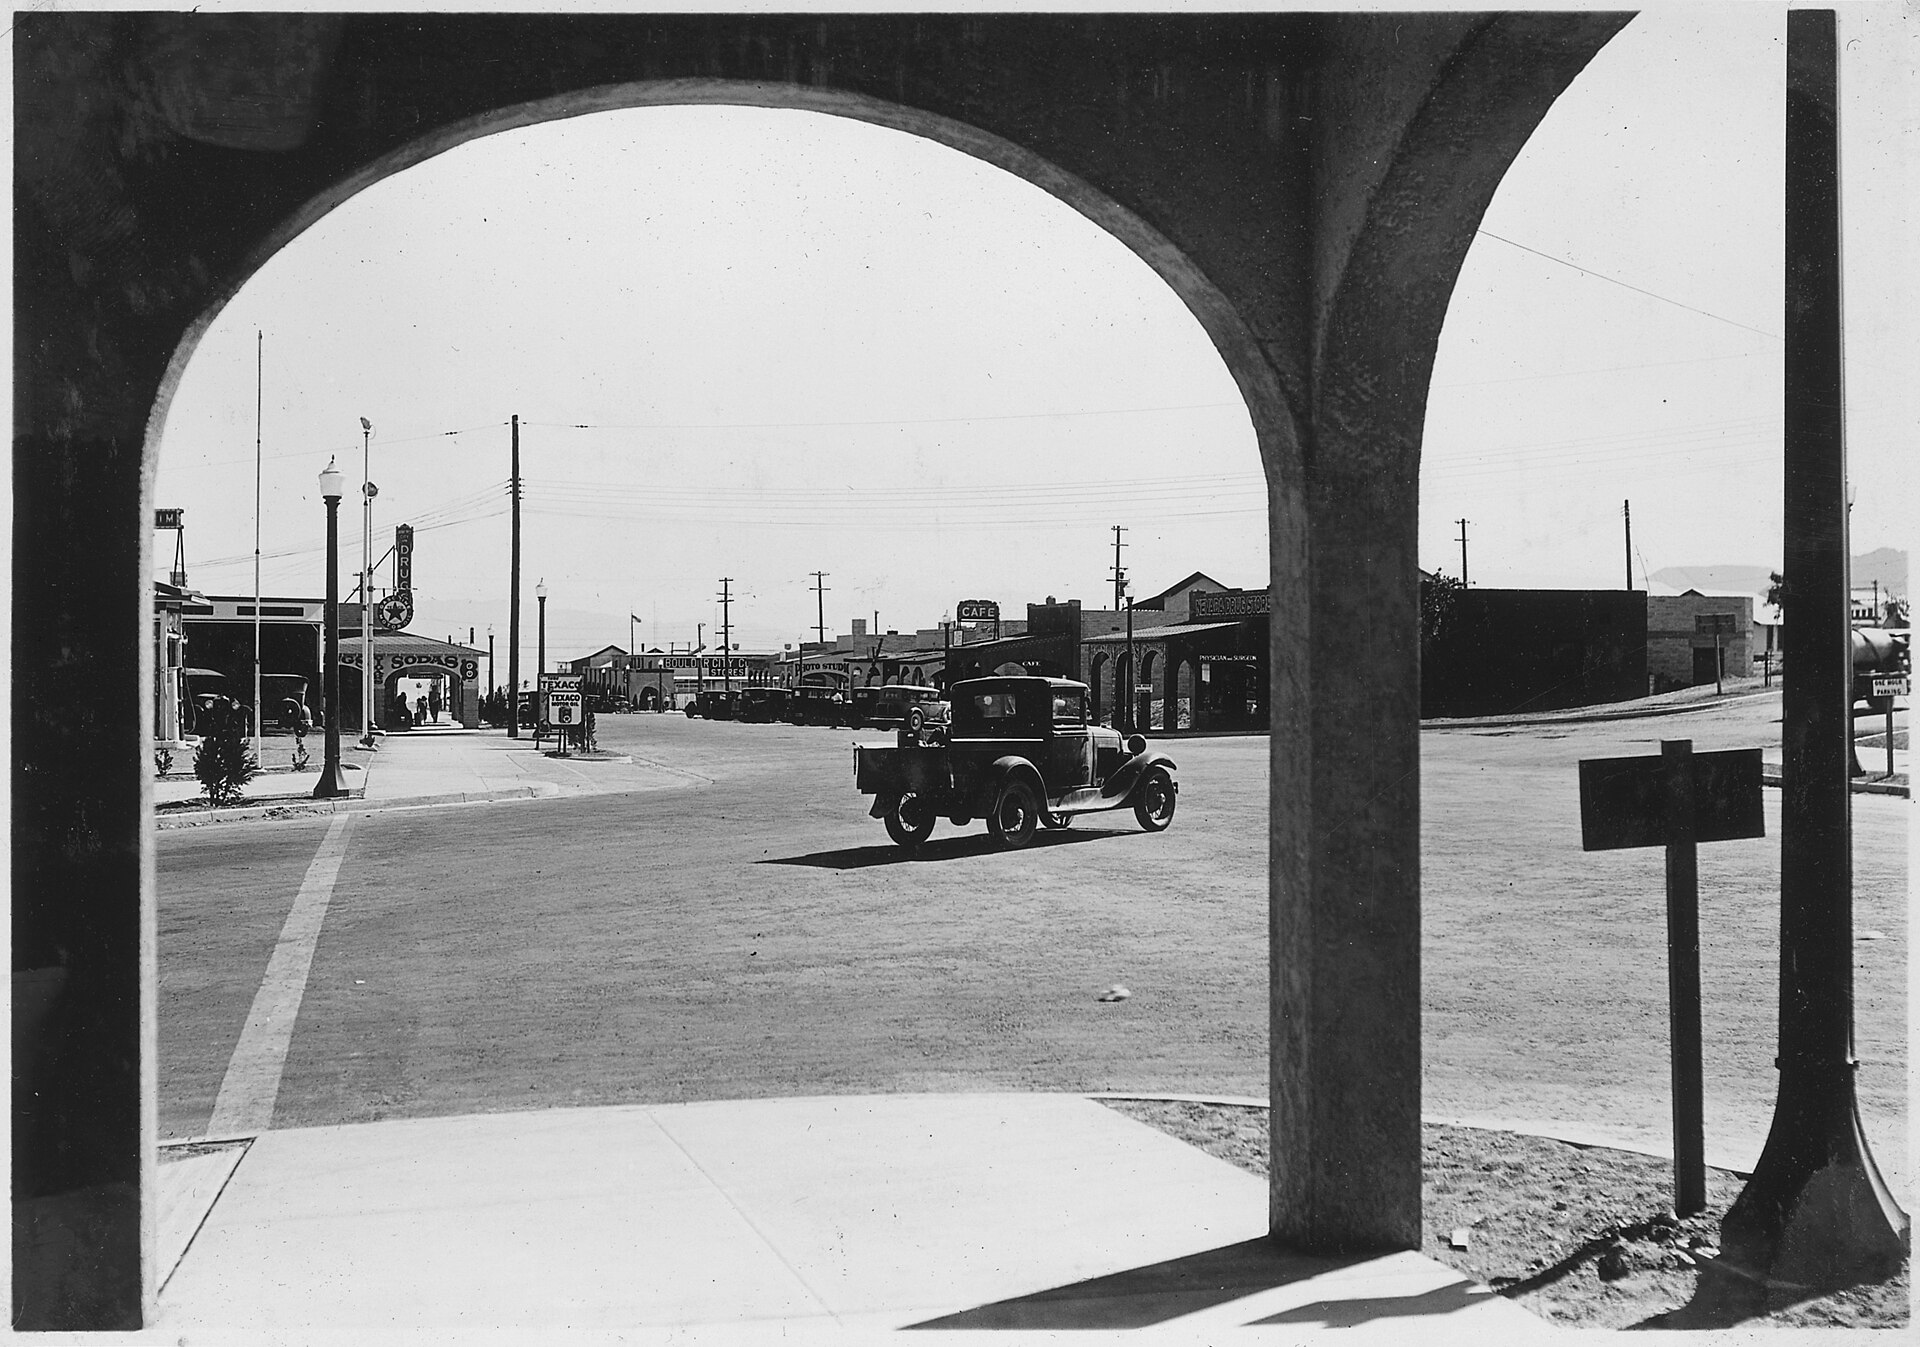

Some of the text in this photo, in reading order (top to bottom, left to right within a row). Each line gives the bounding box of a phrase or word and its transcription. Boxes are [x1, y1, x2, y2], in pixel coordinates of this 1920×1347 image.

[1225, 596, 1246, 615] DRUG
[962, 607, 995, 617] CAFE
[391, 655, 459, 669] SODAS
[665, 658, 709, 668] BOULDR
[711, 668, 744, 676] STORES
[795, 663, 820, 677] PHOTO
[541, 681, 580, 689] TEXACO
